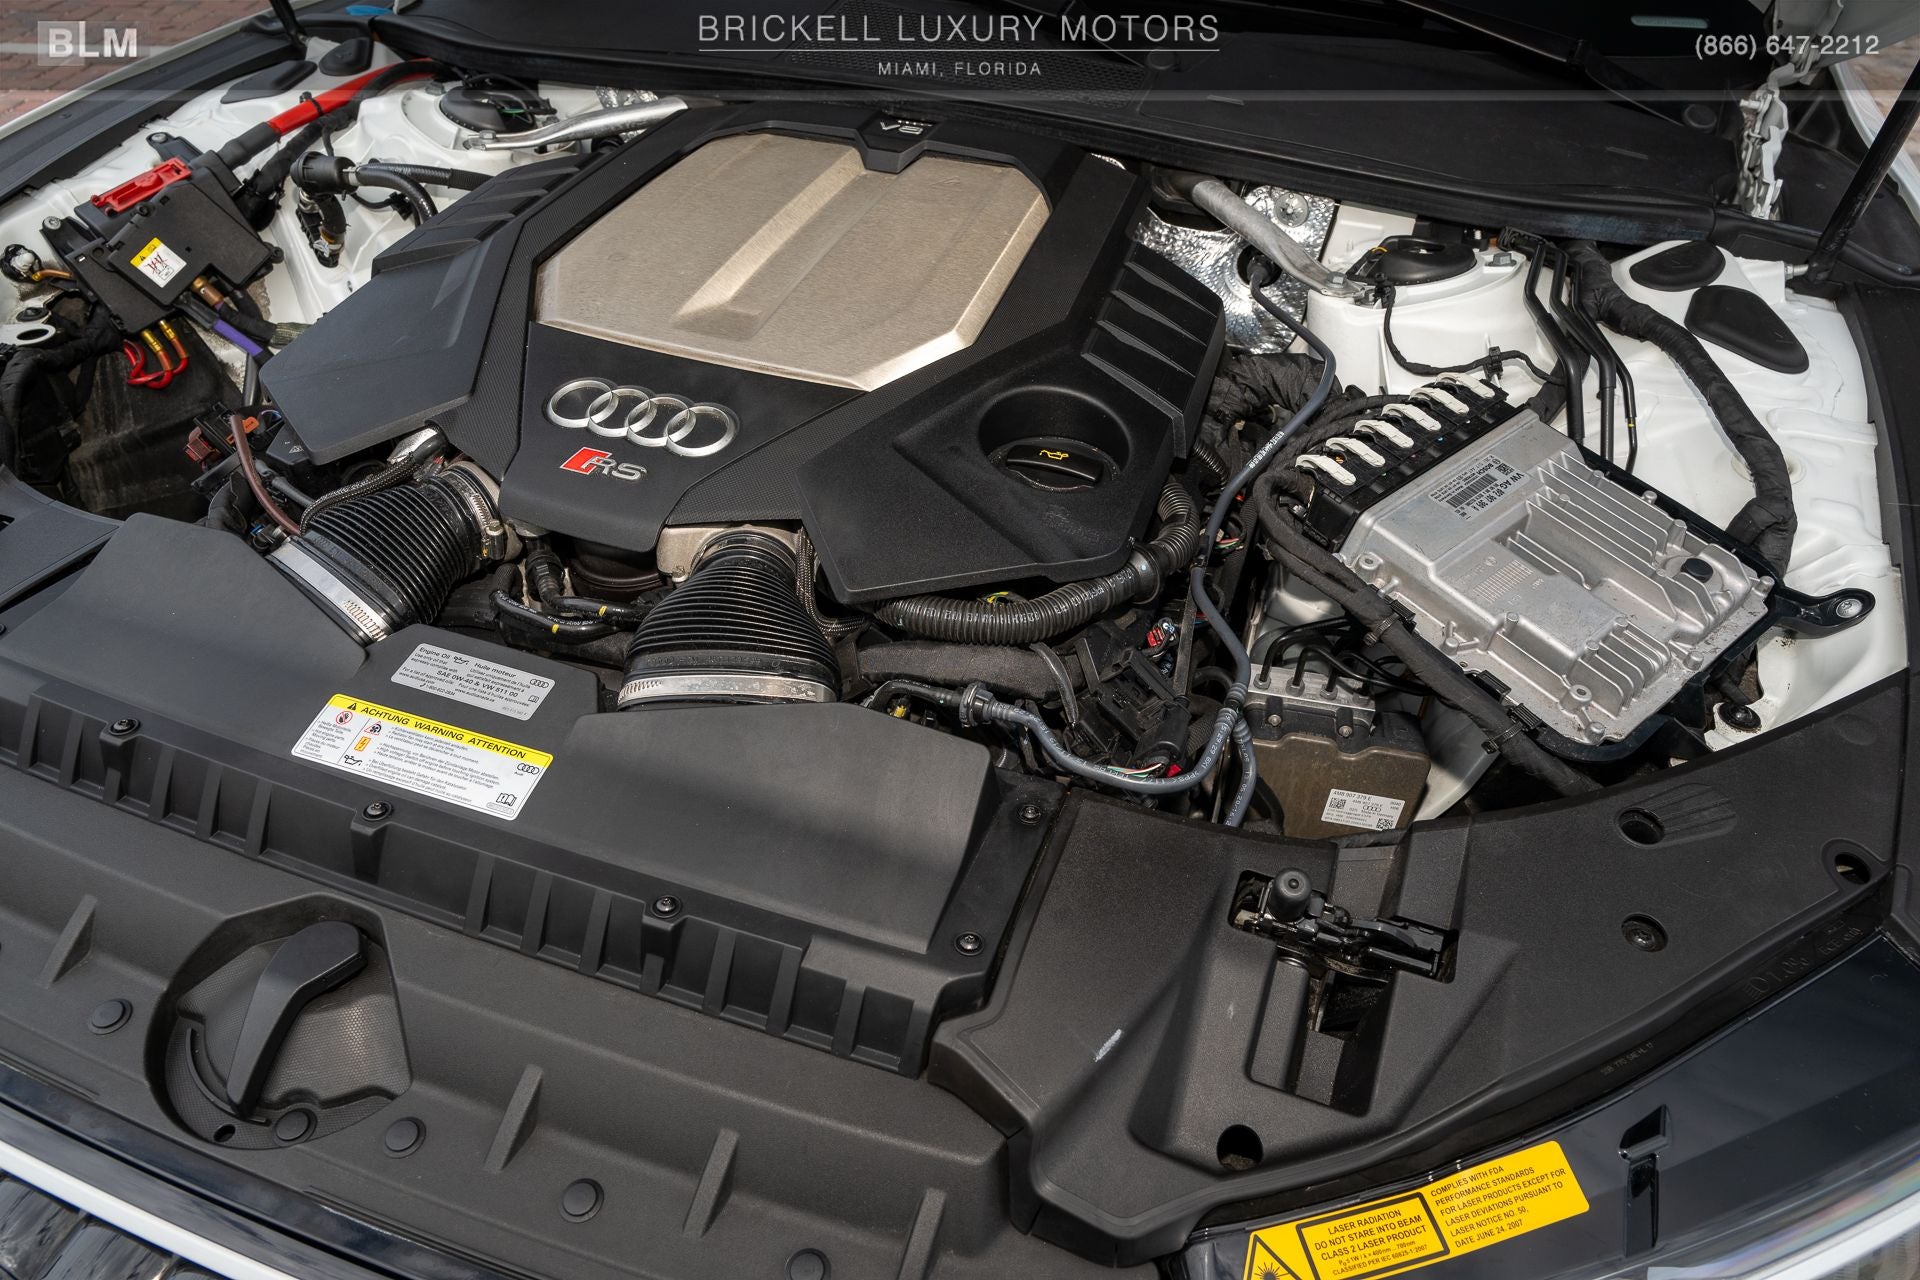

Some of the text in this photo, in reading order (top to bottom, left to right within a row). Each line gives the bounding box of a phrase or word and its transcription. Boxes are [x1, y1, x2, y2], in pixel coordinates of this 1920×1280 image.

[580, 455, 648, 481] RS
[1476, 463, 1494, 475] BOSCH
[1500, 473, 1524, 489] VW AG
[419, 647, 440, 656] Engine
[452, 675, 473, 684] 0W-40
[492, 668, 516, 677] moteur
[361, 707, 526, 758] ACHTUNG WARNING ATTENTION
[1431, 1166, 1504, 1196] COMPLIES WITH FDA
[1435, 1167, 1534, 1206] PERFORMANCE STANDARDS
[1440, 1168, 1566, 1216] FOR LASER PRODUCTS EXCEPT FOR
[1445, 1181, 1563, 1226] LASER DEVIATIONS PURSUANT TO
[1314, 1215, 1422, 1250] DO NOT STARE INTO BEAM
[1328, 1210, 1401, 1234] LASER RADIATION
[1450, 1224, 1475, 1237] LASER
[1476, 1214, 1503, 1228] NOTICE
[1455, 1236, 1475, 1248] DATE
[1477, 1229, 1495, 1240] JUNE
[1507, 1219, 1522, 1230] 2007
[1321, 1247, 1349, 1260] CLASS
[1357, 1237, 1385, 1251] LASER
[1386, 1226, 1426, 1242] PRODUCT
[1333, 1262, 1367, 1275] CLASSIFIED
